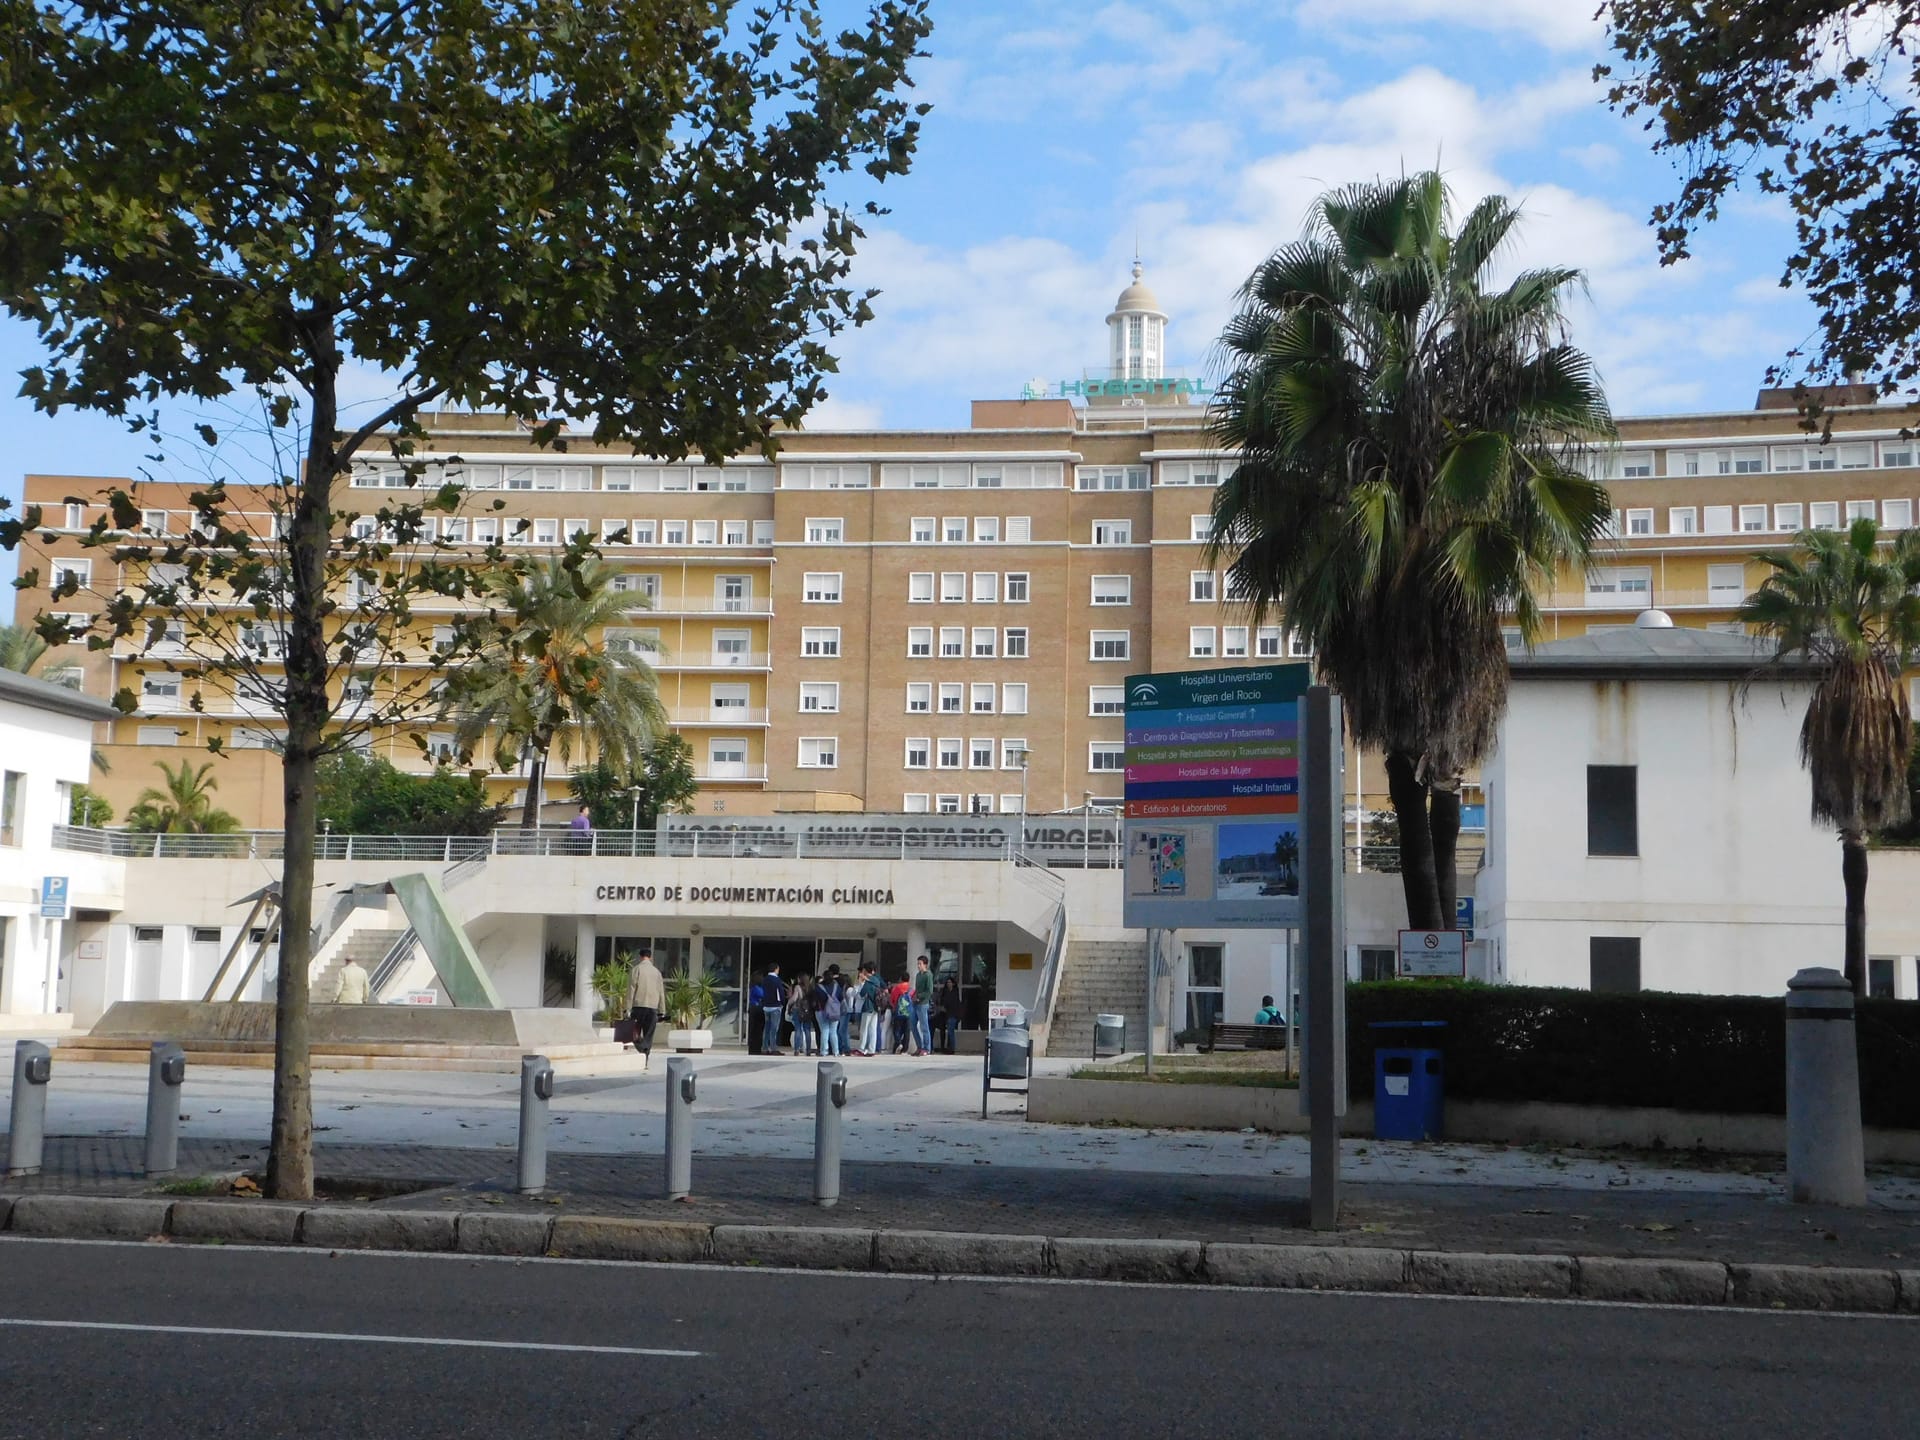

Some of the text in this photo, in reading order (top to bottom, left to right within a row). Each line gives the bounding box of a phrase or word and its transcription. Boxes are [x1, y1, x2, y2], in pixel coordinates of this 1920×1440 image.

[1061, 377, 1214, 396] HOSPITAL
[1180, 671, 1273, 686] Hospital Universitario
[1191, 689, 1262, 704] Virgen del Rocío
[1186, 710, 1248, 722] Hospital General
[1143, 732, 1168, 742] Centro
[1169, 732, 1179, 741] de
[1230, 727, 1275, 738] Tratamiento
[1137, 750, 1167, 761] Hospital
[1168, 751, 1178, 760] de
[1178, 765, 1252, 777] Hospital de la Mujer
[1232, 782, 1291, 794] Hospital Infantil
[1143, 802, 1228, 814] Edificio de Laboratorios
[668, 824, 1123, 851] HOSPITAL UNIVERSITARIO VIRGEN
[50, 878, 64, 896] P
[596, 885, 895, 905] CENTRO DE DOCUMENTACIÓN CLÍNICA
